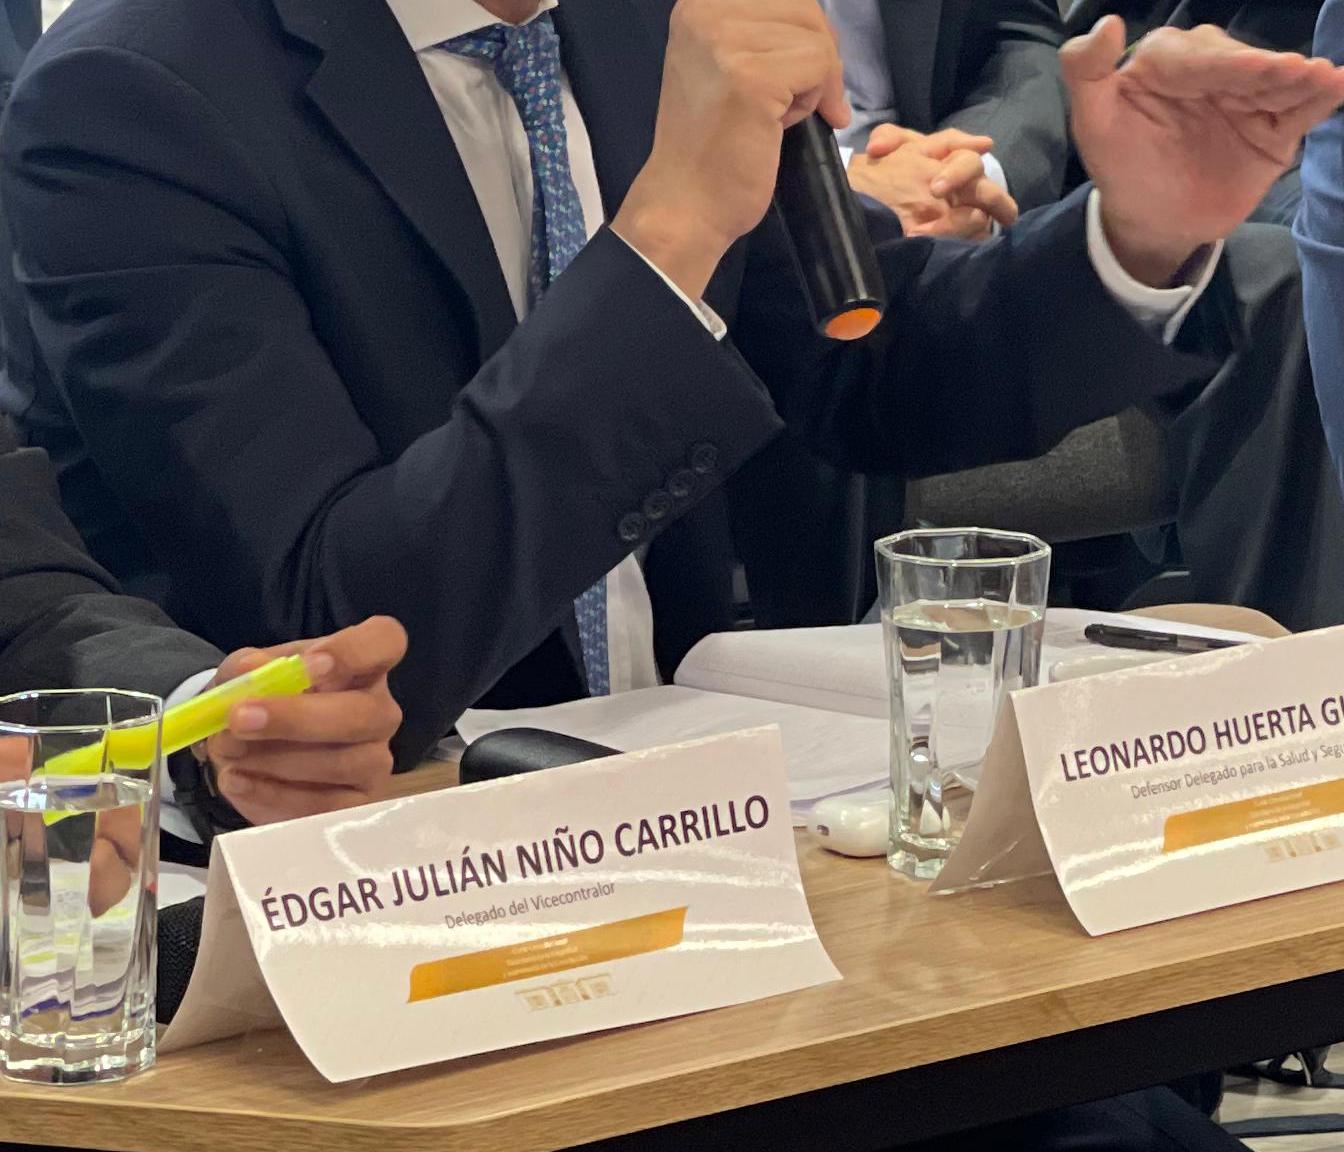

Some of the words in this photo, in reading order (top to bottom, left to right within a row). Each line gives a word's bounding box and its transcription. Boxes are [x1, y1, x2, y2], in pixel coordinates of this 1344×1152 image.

[1060, 725, 1207, 782] LEONARDO
[1212, 703, 1316, 750] HUERTA
[1131, 777, 1181, 799] Defensor
[1184, 763, 1237, 788] Delegado
[1239, 759, 1265, 778] para
[1266, 756, 1277, 769] la
[1279, 748, 1309, 768] Salud
[1312, 749, 1319, 762] y
[261, 877, 384, 931] ÉDGAR
[391, 845, 508, 907] JULIÁN
[515, 825, 605, 879] NIÑO
[614, 794, 769, 857] CARRILLO
[444, 903, 507, 930] Delegado
[509, 897, 530, 916] del
[531, 880, 616, 911] Vicecontralor
